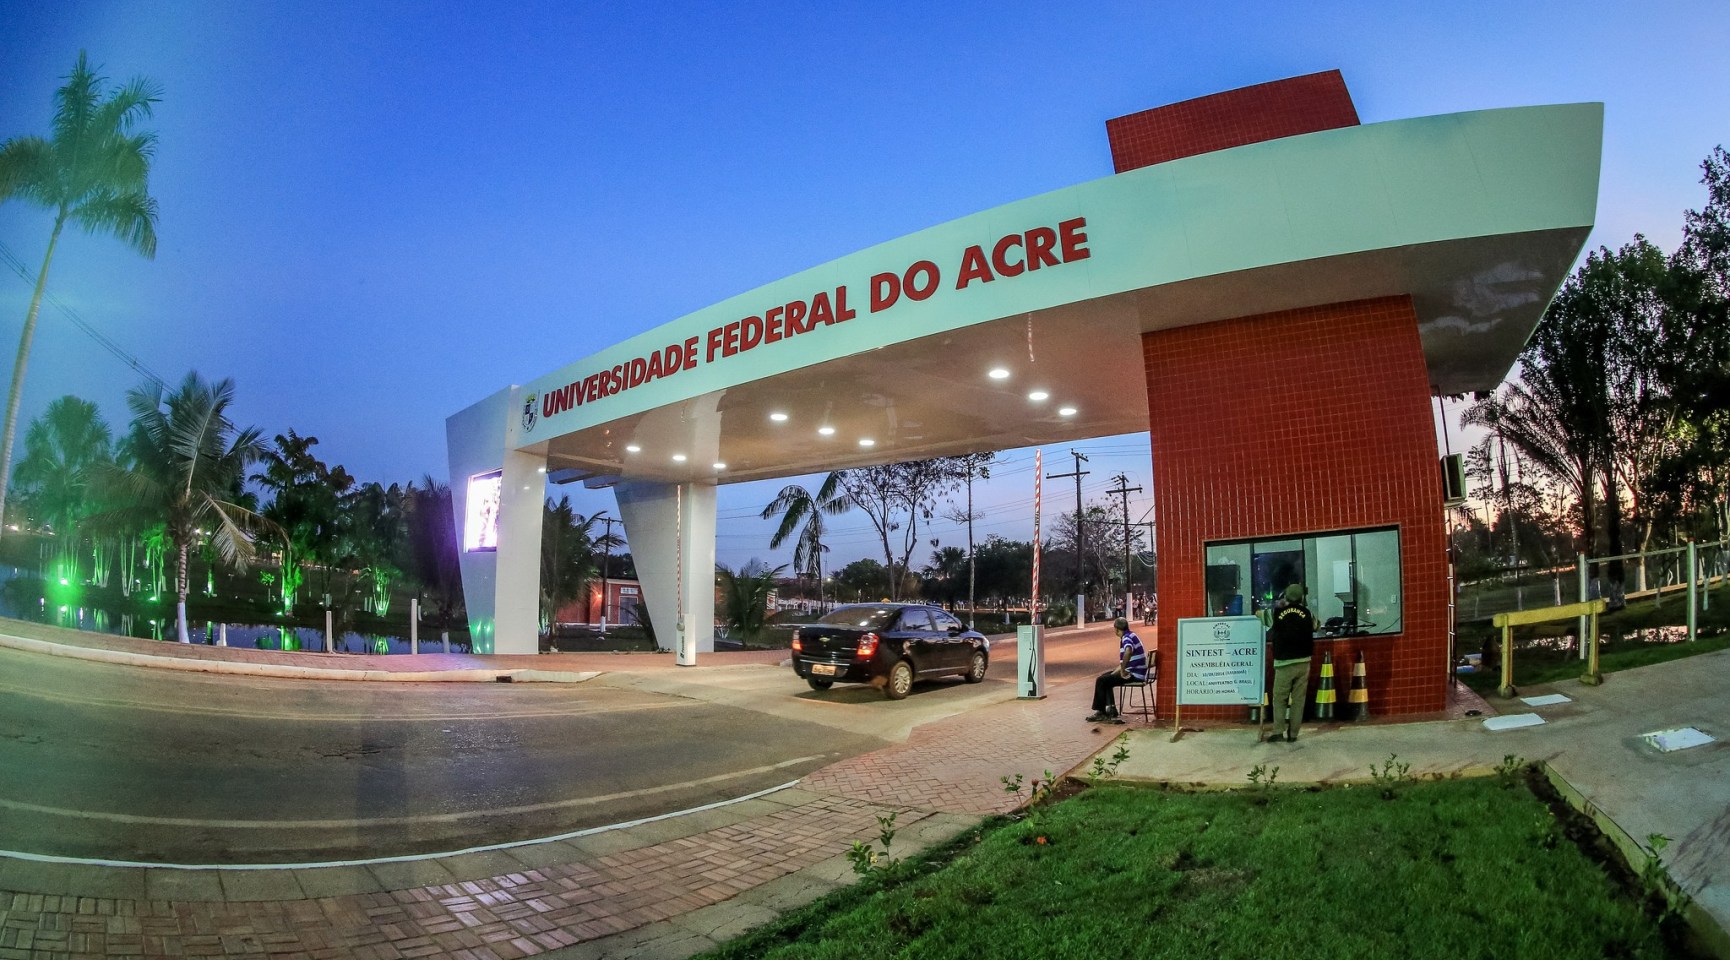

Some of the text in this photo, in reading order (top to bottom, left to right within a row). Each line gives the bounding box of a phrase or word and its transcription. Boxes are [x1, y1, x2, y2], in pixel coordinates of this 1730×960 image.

[543, 216, 1091, 418] UNIVERSIDADE FEDERAL DO ACRE
[1186, 648, 1224, 657] SINTEST
[1232, 647, 1258, 656] ACRE
